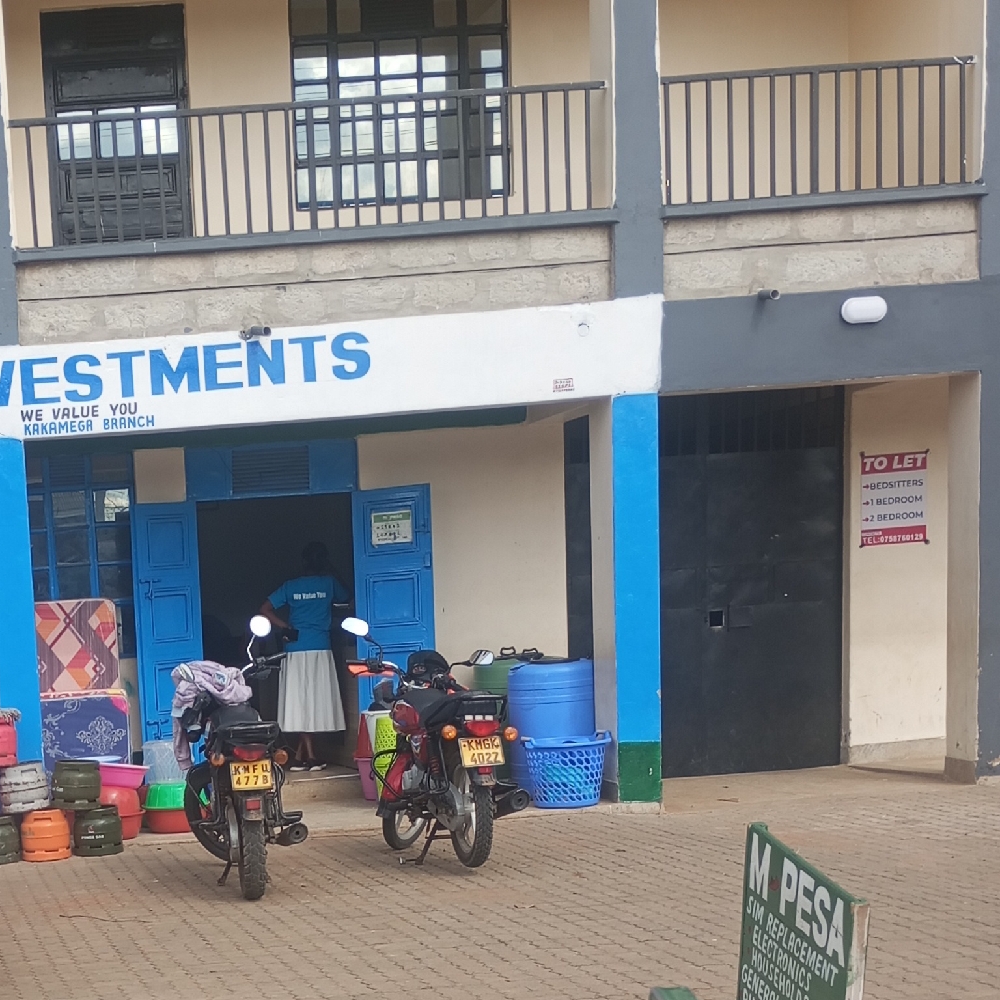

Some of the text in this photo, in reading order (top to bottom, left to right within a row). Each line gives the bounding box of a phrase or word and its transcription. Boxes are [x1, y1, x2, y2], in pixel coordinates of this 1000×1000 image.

[20, 402, 138, 422] WE VALUE YOU
[24, 415, 155, 436] KAKAMEGA BRANCH
[863, 453, 926, 472] TO LET
[870, 479, 924, 490] BEDSITTERS
[870, 495, 923, 506] 1 BEDROOM
[877, 511, 924, 522] BEDROOM
[235, 775, 269, 786] 477B
[746, 896, 839, 987] SIM REPLACEMENT
[752, 925, 812, 992] ELECTRONICS
